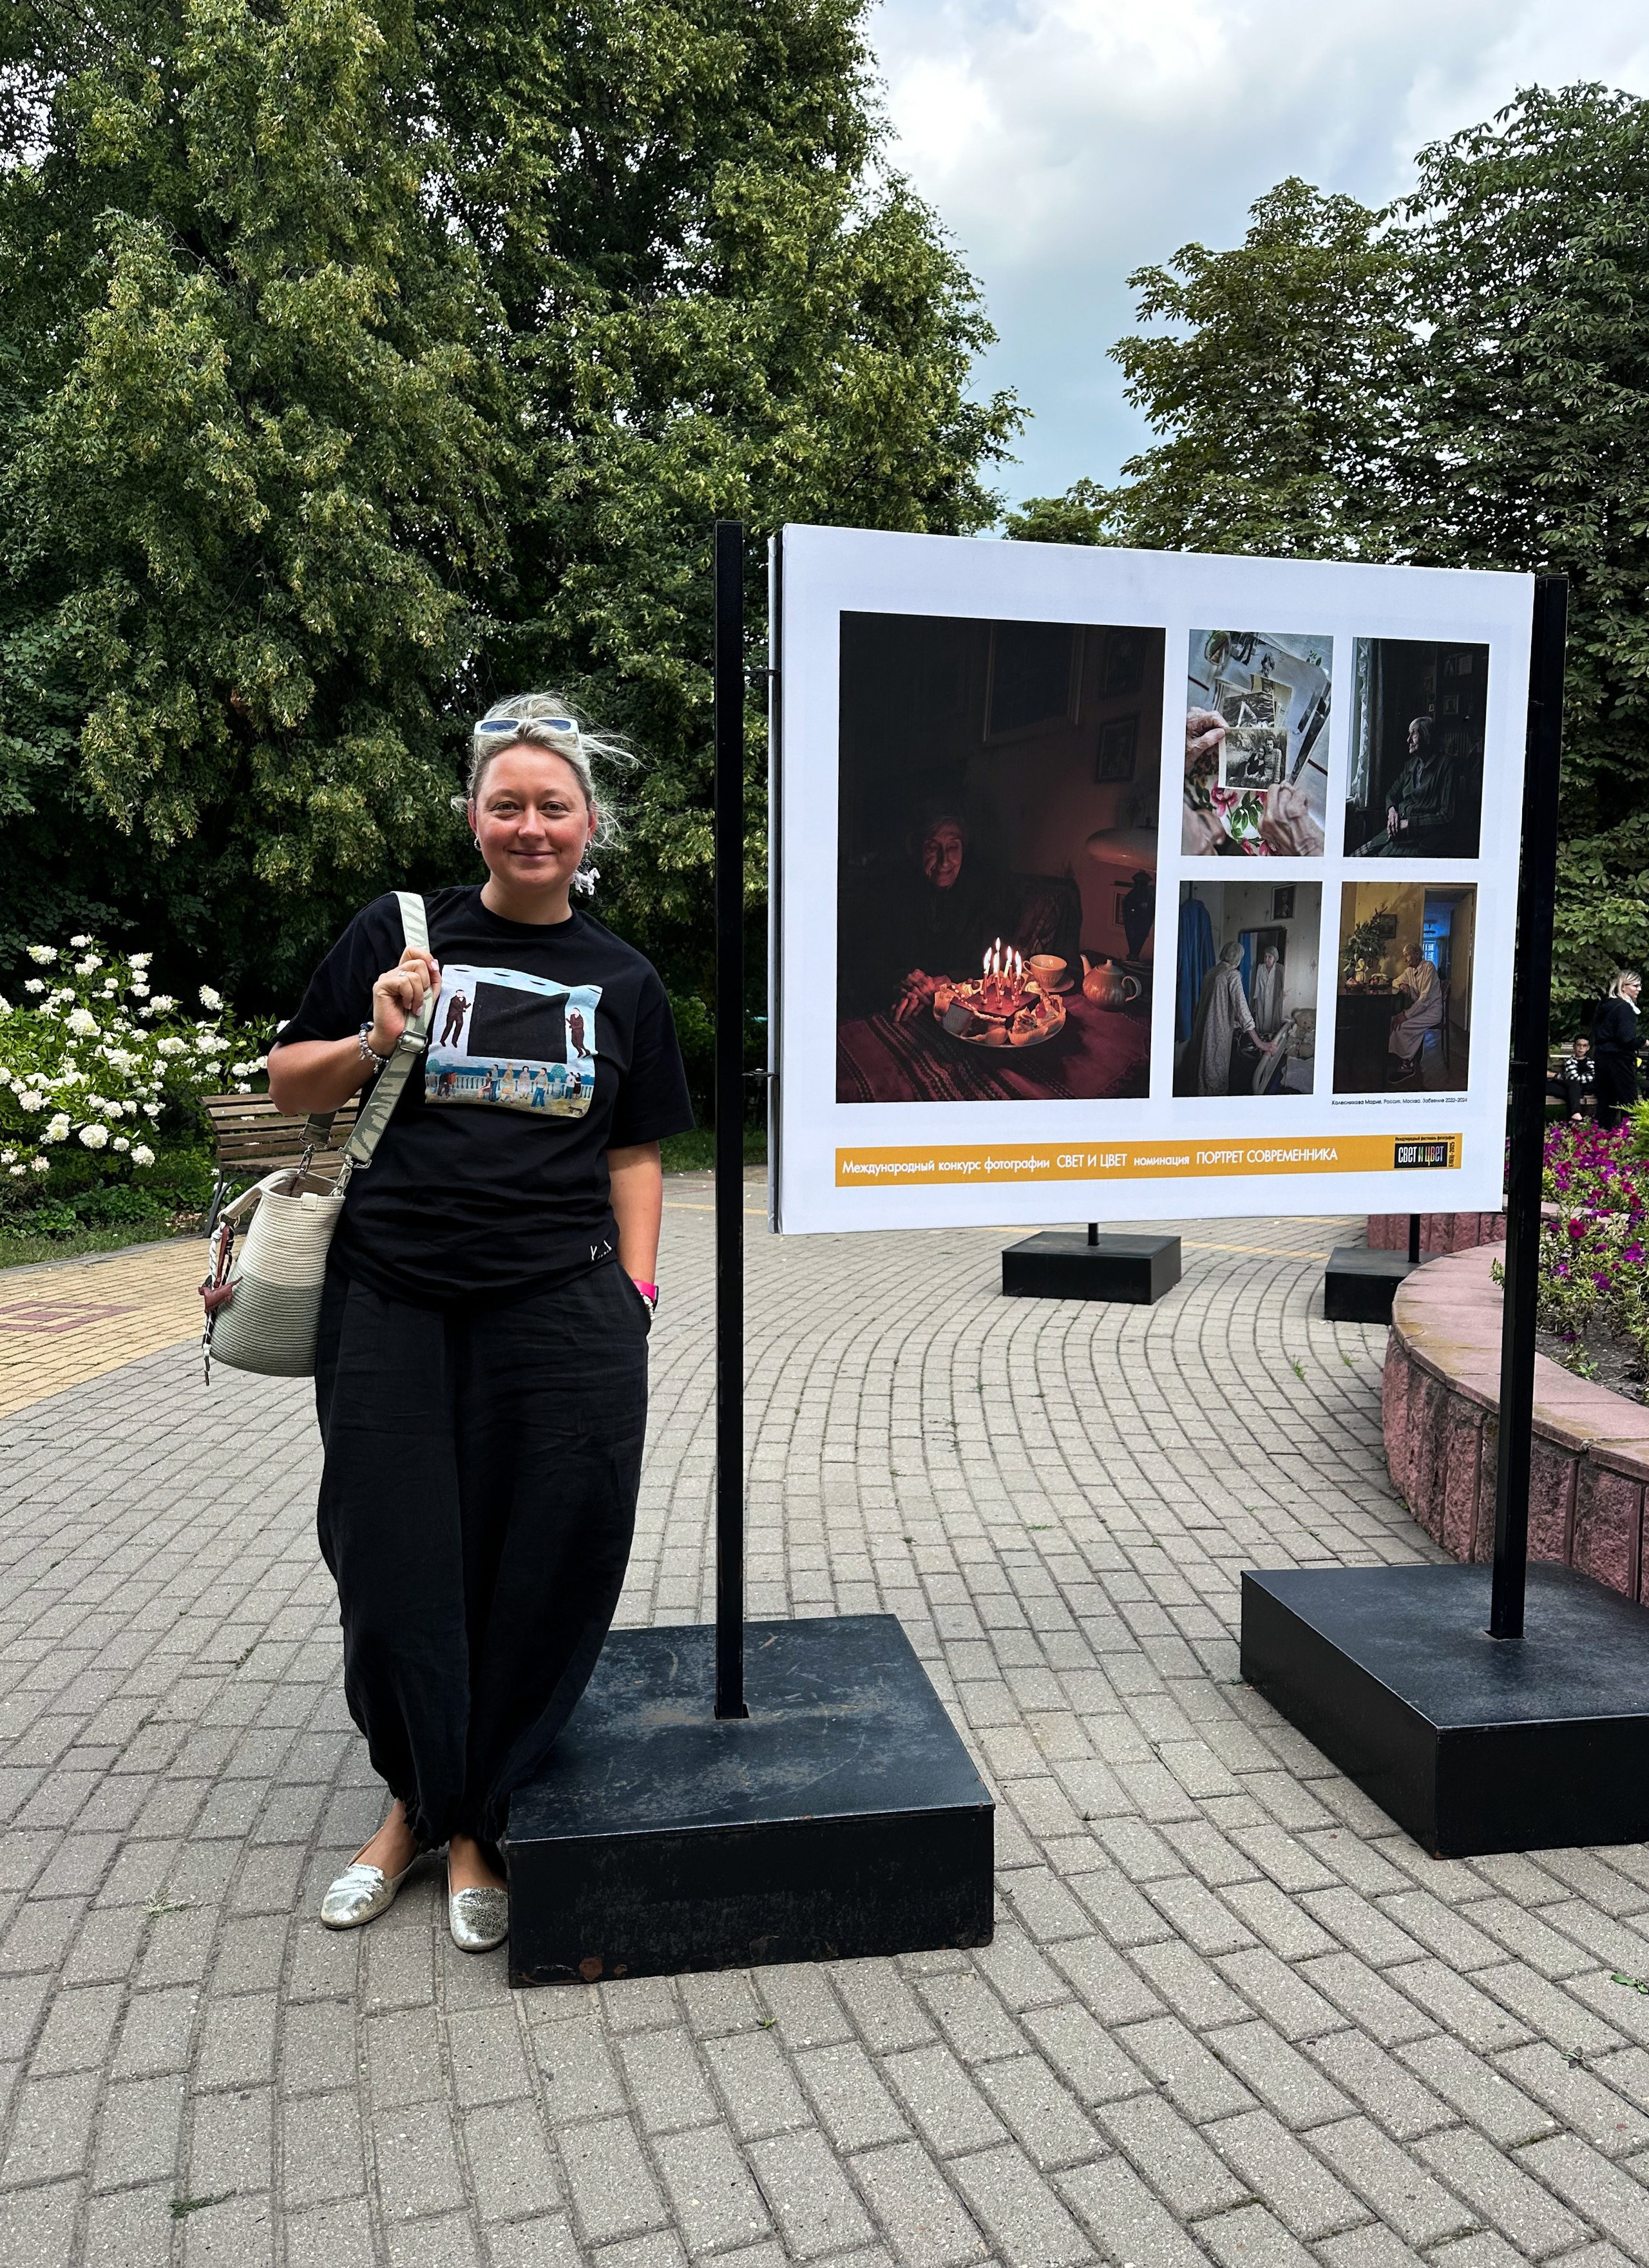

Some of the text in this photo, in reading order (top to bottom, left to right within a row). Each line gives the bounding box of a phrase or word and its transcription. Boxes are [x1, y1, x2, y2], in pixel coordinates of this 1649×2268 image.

[842, 1147, 1339, 1177] Международный конкурс фотографии СВЕТ И ЦВЕТ номинация ПОРТРЕТ СОВРЕМЕННИКА
